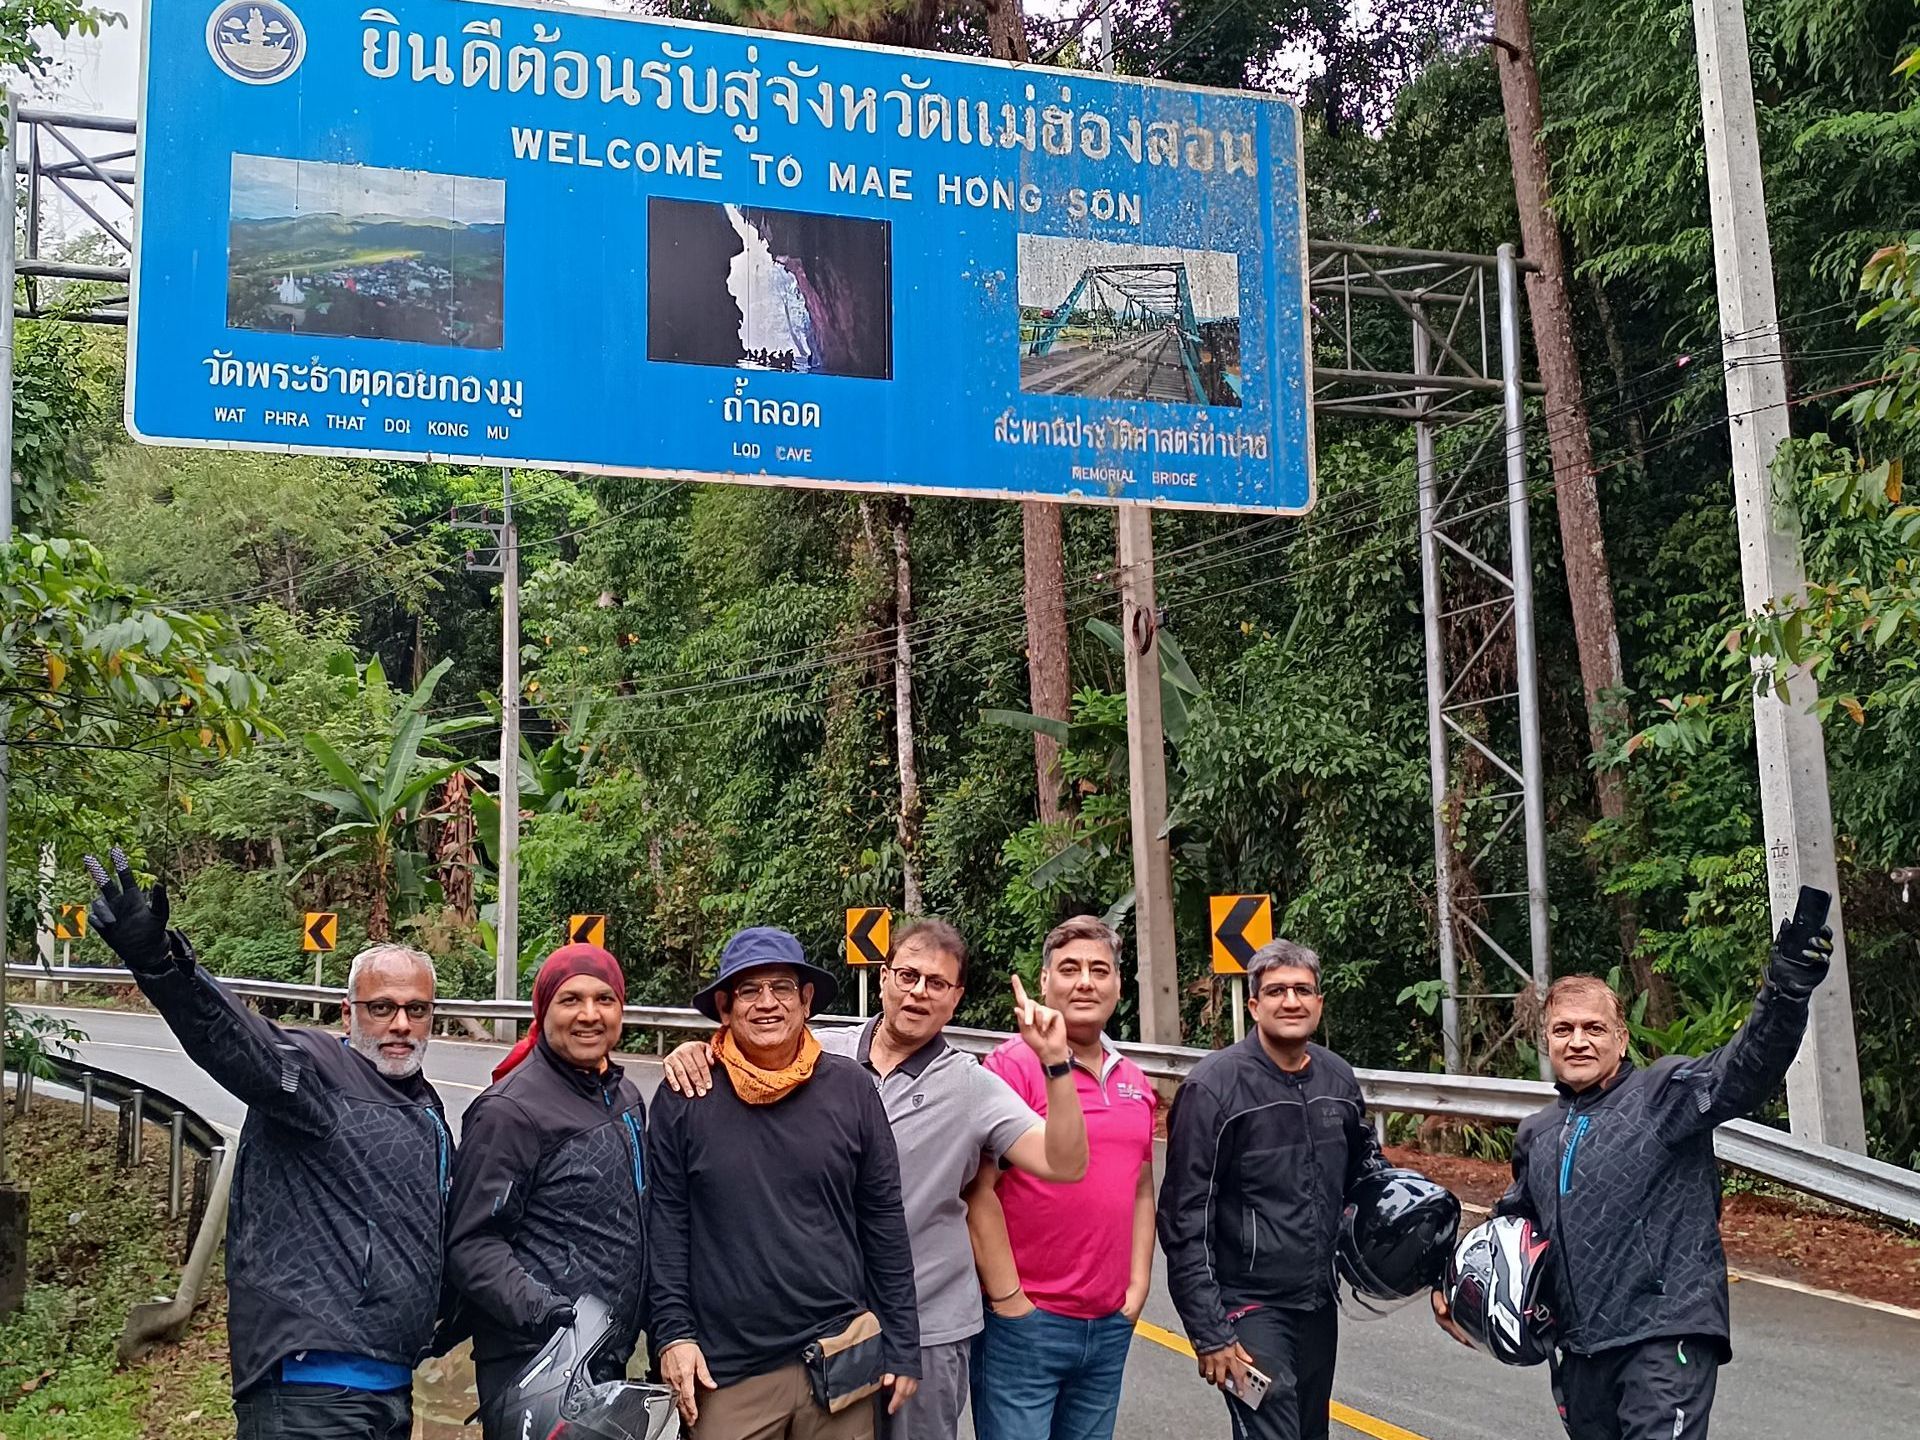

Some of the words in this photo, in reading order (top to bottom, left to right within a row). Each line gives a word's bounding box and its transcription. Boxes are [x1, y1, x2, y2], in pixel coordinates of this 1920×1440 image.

[360, 8, 1258, 177] ยินดีต้อนรับสู่จังหวัดแม่ฮ่องสอน
[511, 126, 723, 181] WELCOME
[750, 152, 803, 188] TO
[828, 162, 913, 201] MAE
[938, 173, 1043, 213] HONG
[1068, 188, 1141, 226] SON
[202, 349, 524, 418] วัดพระธาตุดอยกองมู
[723, 376, 821, 428] ถ้ำลอด
[214, 406, 246, 424] WAT
[264, 409, 310, 428] PHRA
[326, 413, 367, 432] THAT
[384, 419, 411, 435] DOI
[428, 420, 470, 438] KONG
[486, 425, 510, 441] MU
[732, 441, 761, 459] LOD
[775, 444, 813, 463] CAVE
[1071, 465, 1138, 484] MEMORIAL
[1151, 470, 1198, 487] BRIDGE
